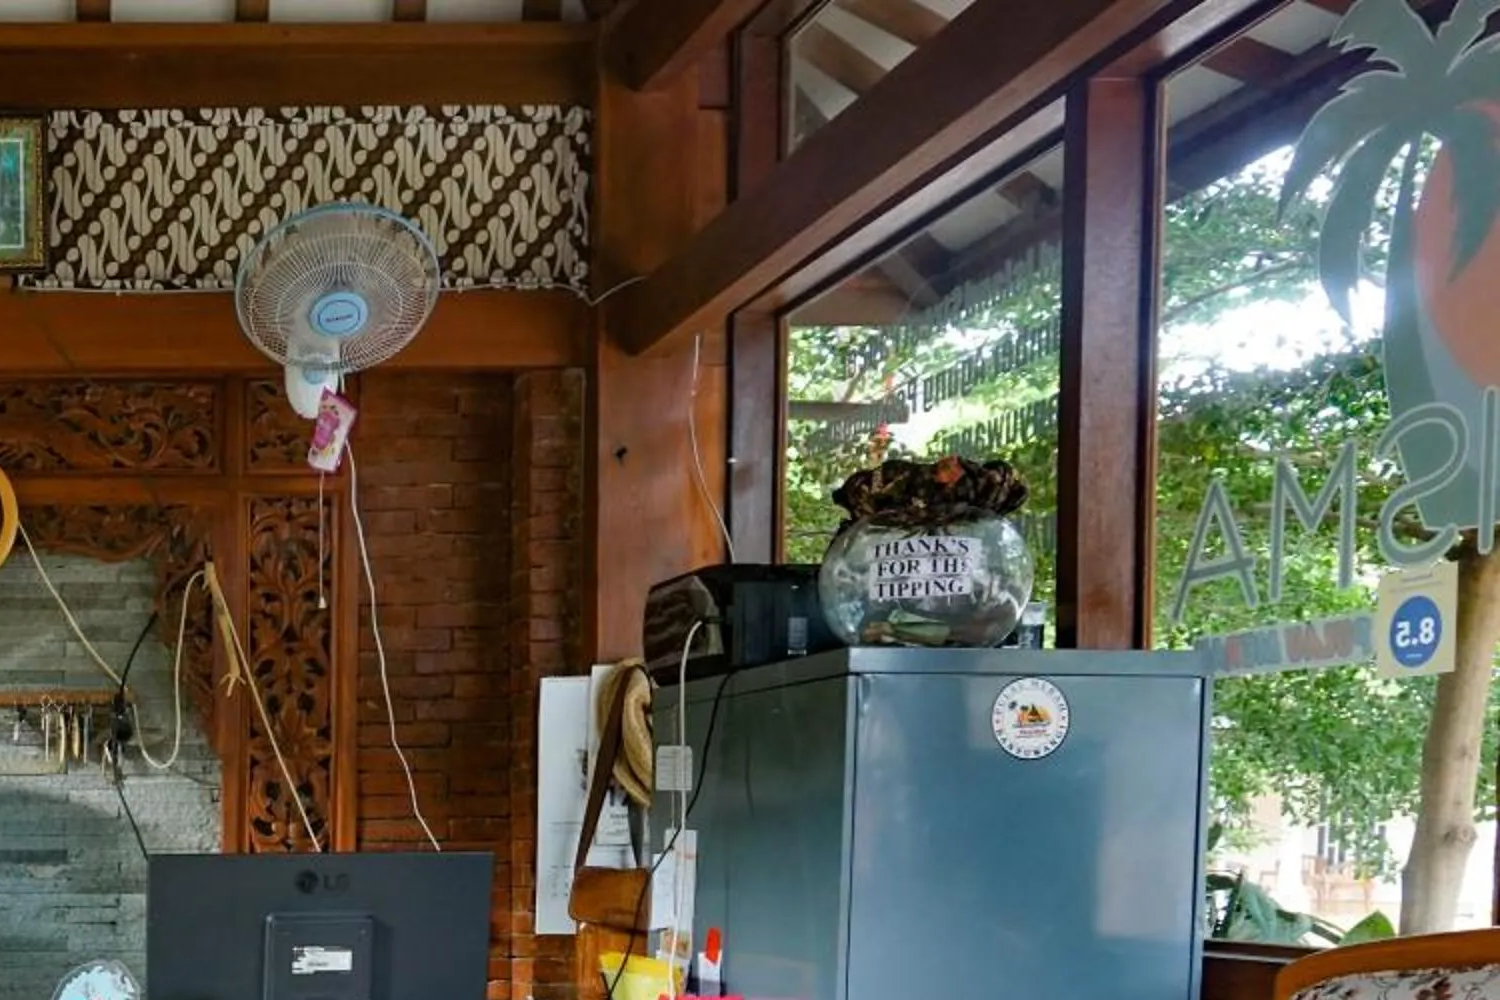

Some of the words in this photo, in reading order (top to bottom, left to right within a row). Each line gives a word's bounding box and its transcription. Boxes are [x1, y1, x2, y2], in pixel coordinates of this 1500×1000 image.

[874, 537, 970, 558] THANK'S
[877, 558, 920, 577] FOR
[875, 579, 965, 598] TIPPING
[323, 873, 350, 891] LG
